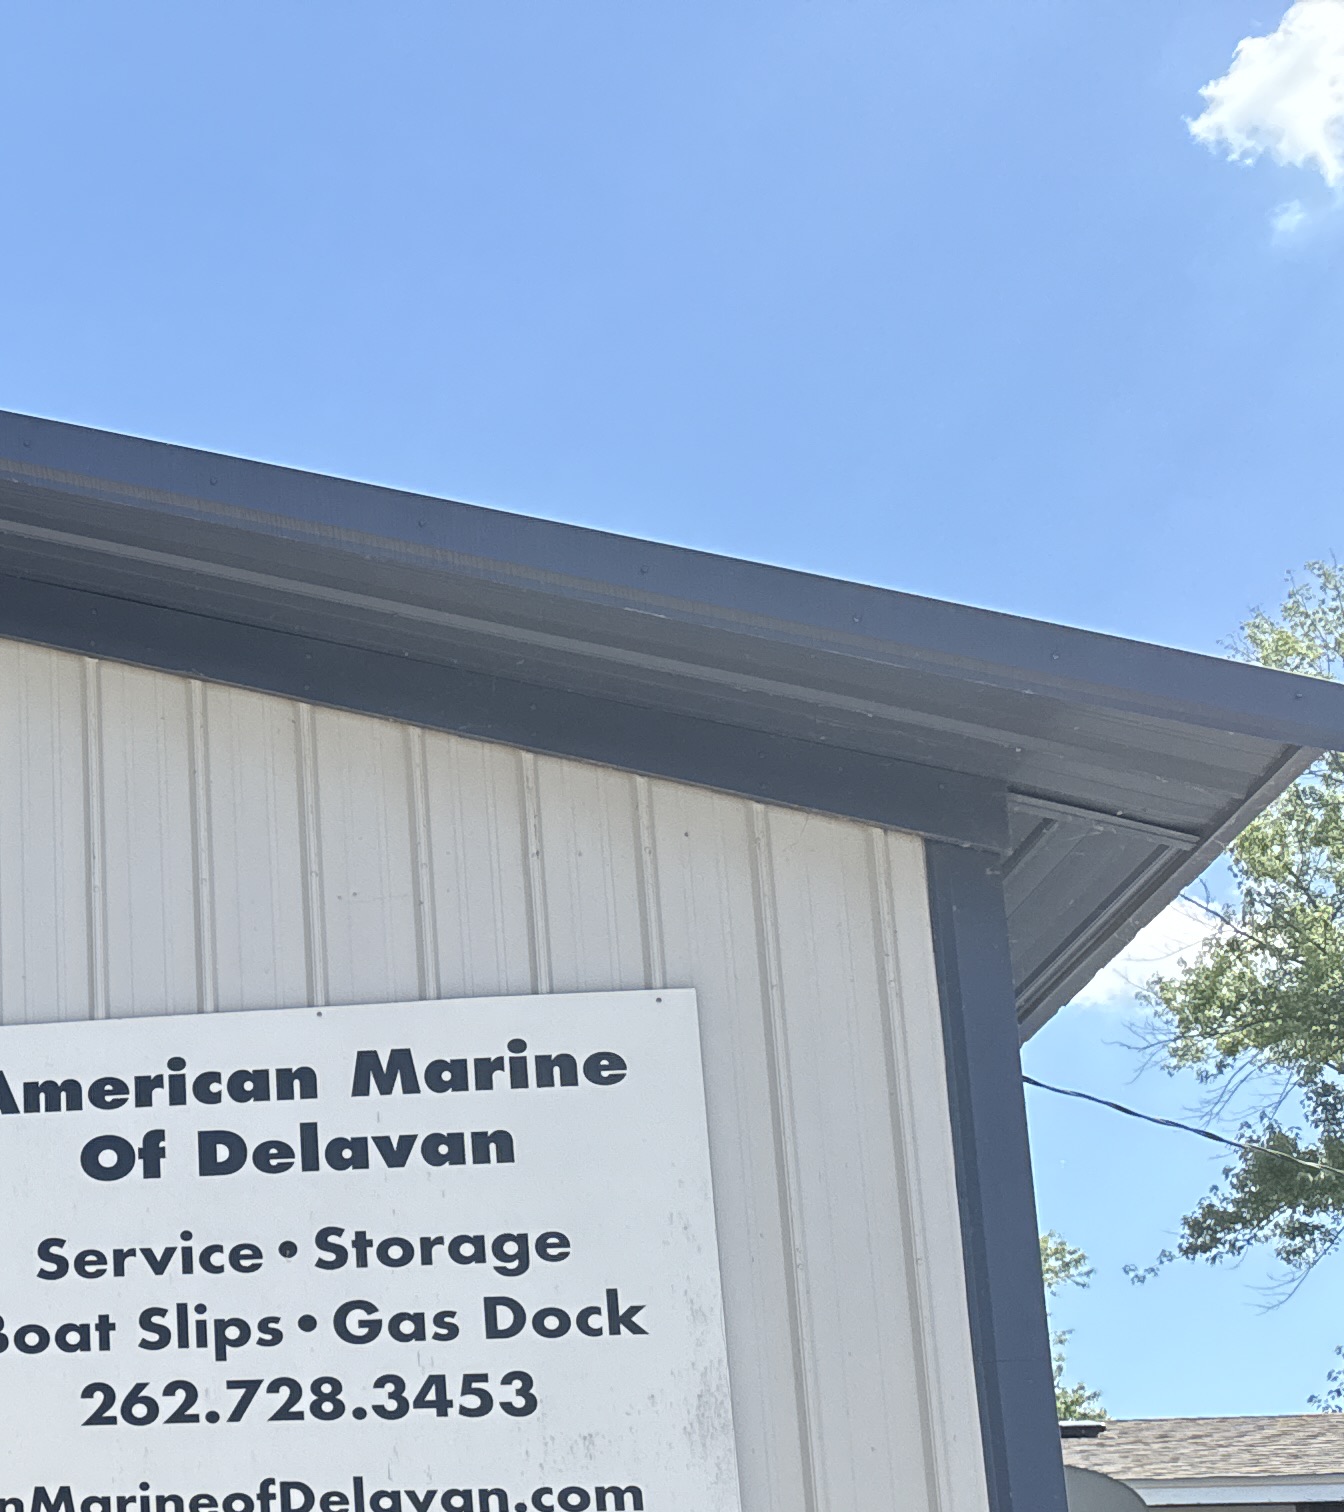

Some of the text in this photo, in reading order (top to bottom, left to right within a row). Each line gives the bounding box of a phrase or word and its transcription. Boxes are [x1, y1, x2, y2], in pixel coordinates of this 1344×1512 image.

[352, 1039, 628, 1097] Marine
[80, 1122, 515, 1182] Of Delavan
[37, 1227, 571, 1281] Service Storage
[138, 1303, 284, 1362] Slips
[333, 1299, 460, 1345] Gas
[483, 1289, 649, 1340] Dock
[80, 1371, 538, 1426] 262.728.3453
